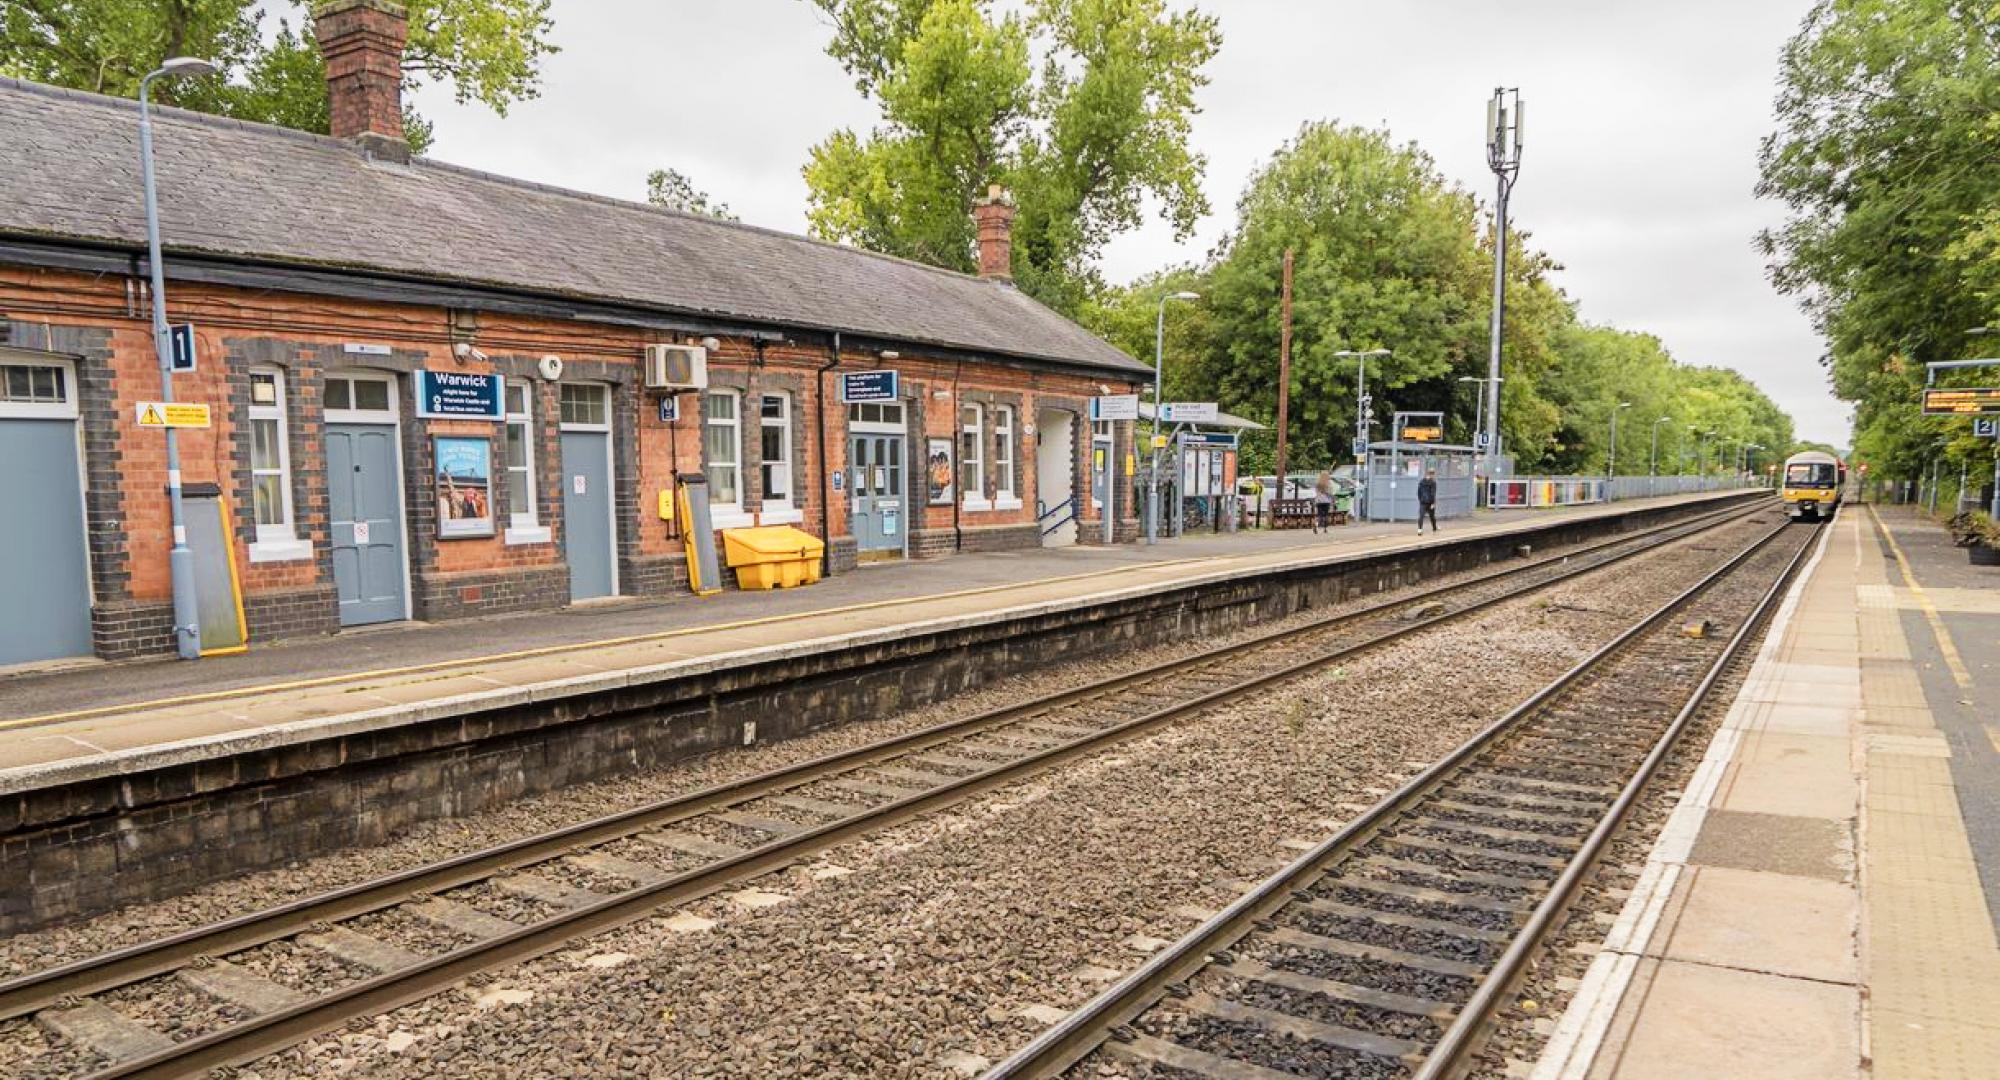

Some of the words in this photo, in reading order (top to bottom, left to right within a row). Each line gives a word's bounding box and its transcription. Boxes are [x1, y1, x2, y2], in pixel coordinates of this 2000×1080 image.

[176, 331, 186, 361] 1
[435, 372, 488, 388] Warwick
[1980, 420, 1991, 432] 2
